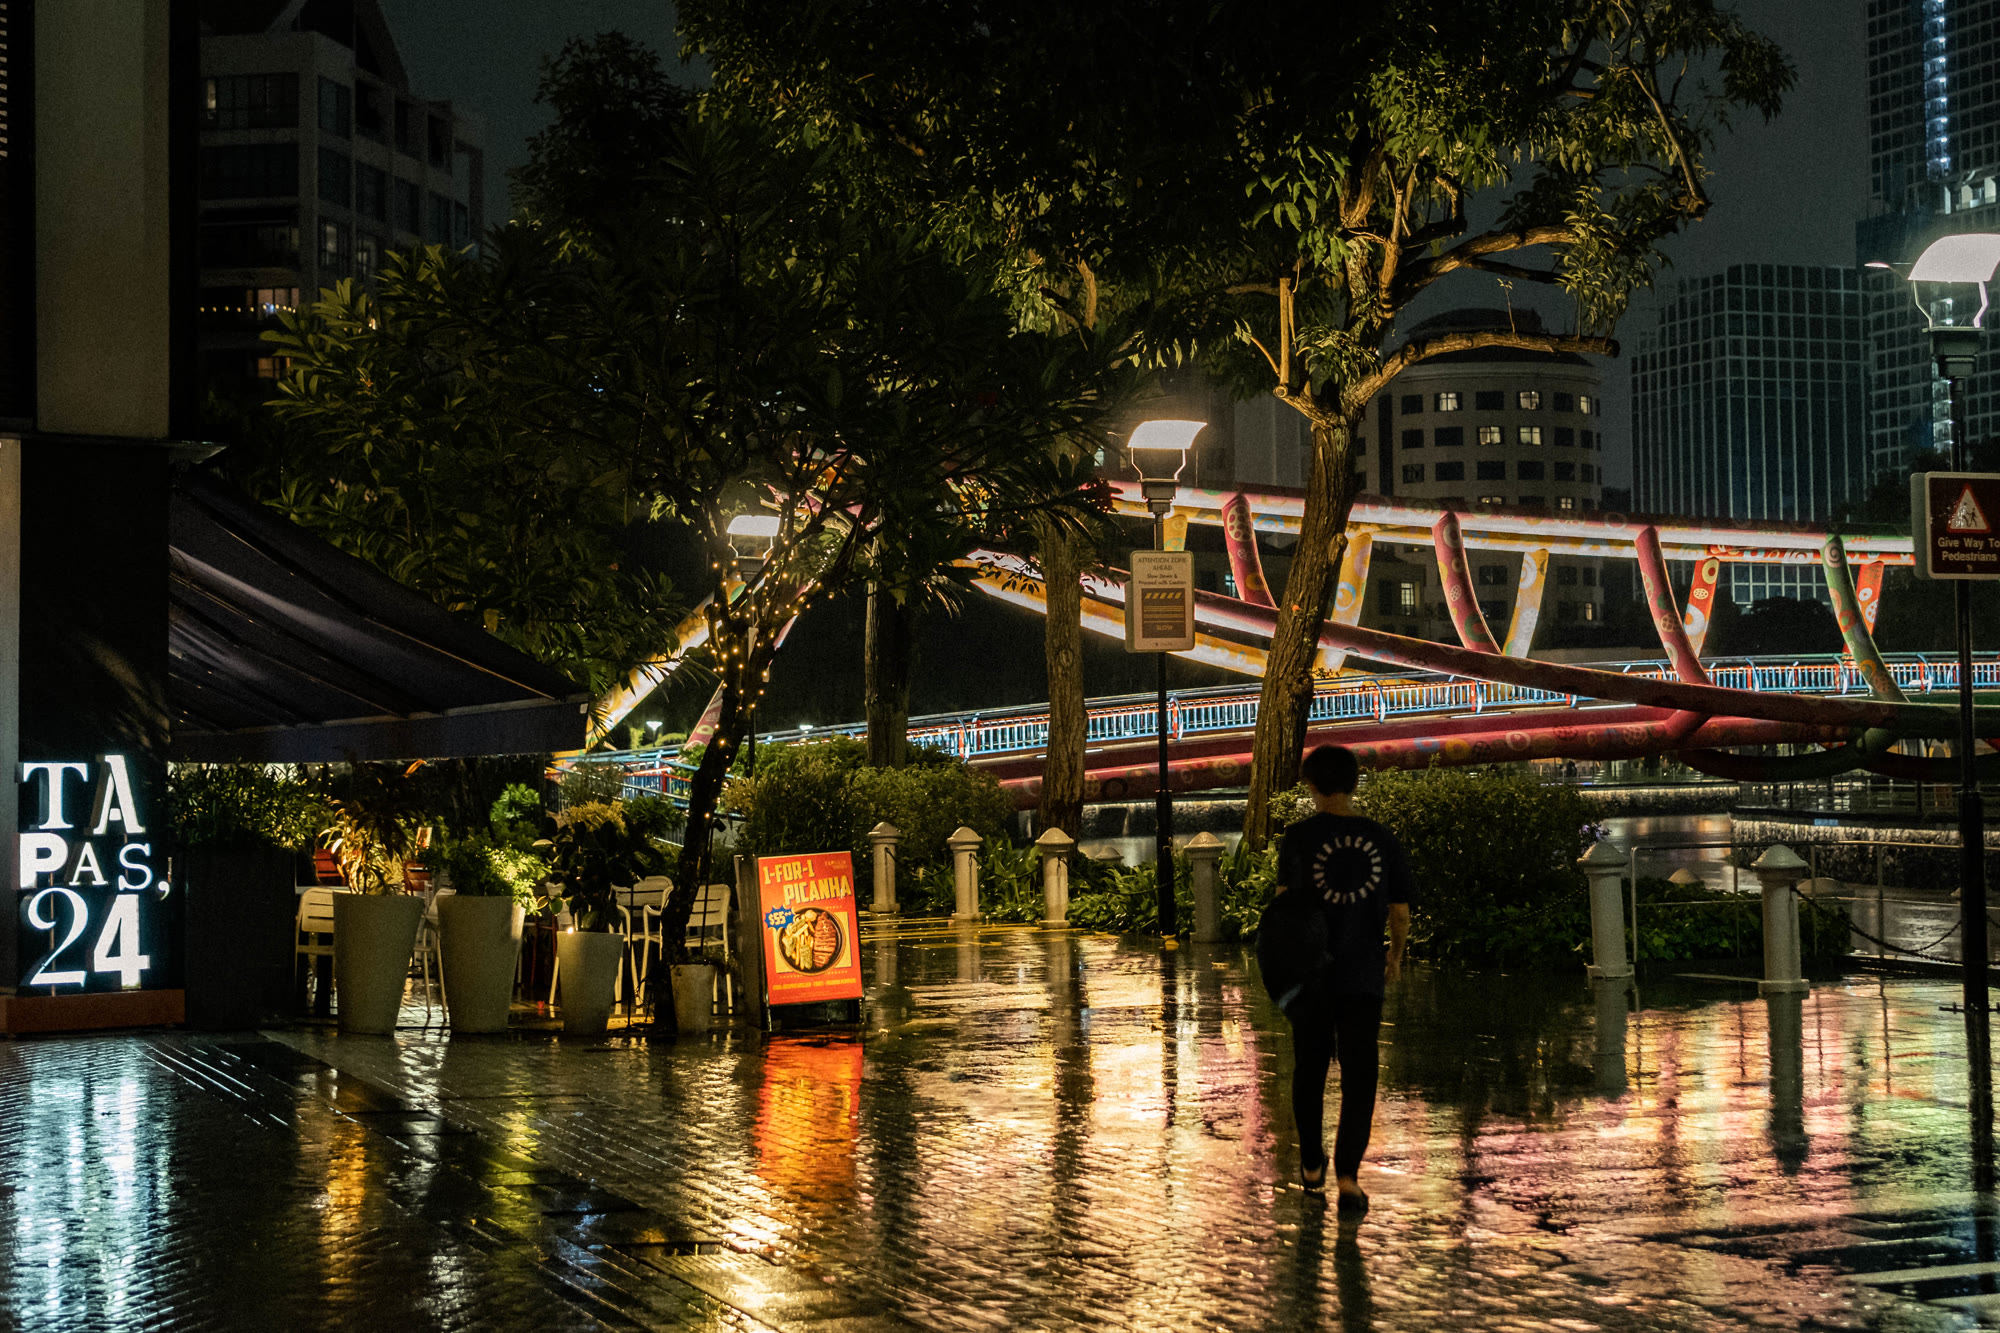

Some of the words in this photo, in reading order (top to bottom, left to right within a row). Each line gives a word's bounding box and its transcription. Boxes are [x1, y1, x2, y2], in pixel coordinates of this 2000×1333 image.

[1938, 537, 1959, 548] Give
[1963, 538, 1984, 550] Way
[1988, 538, 2000, 548] To
[1942, 551, 1997, 562] Pedestrians
[22, 754, 146, 835] TA
[763, 859, 815, 885] 1-FOR-1
[783, 875, 852, 906] PICANHA
[27, 887, 150, 989] 24
